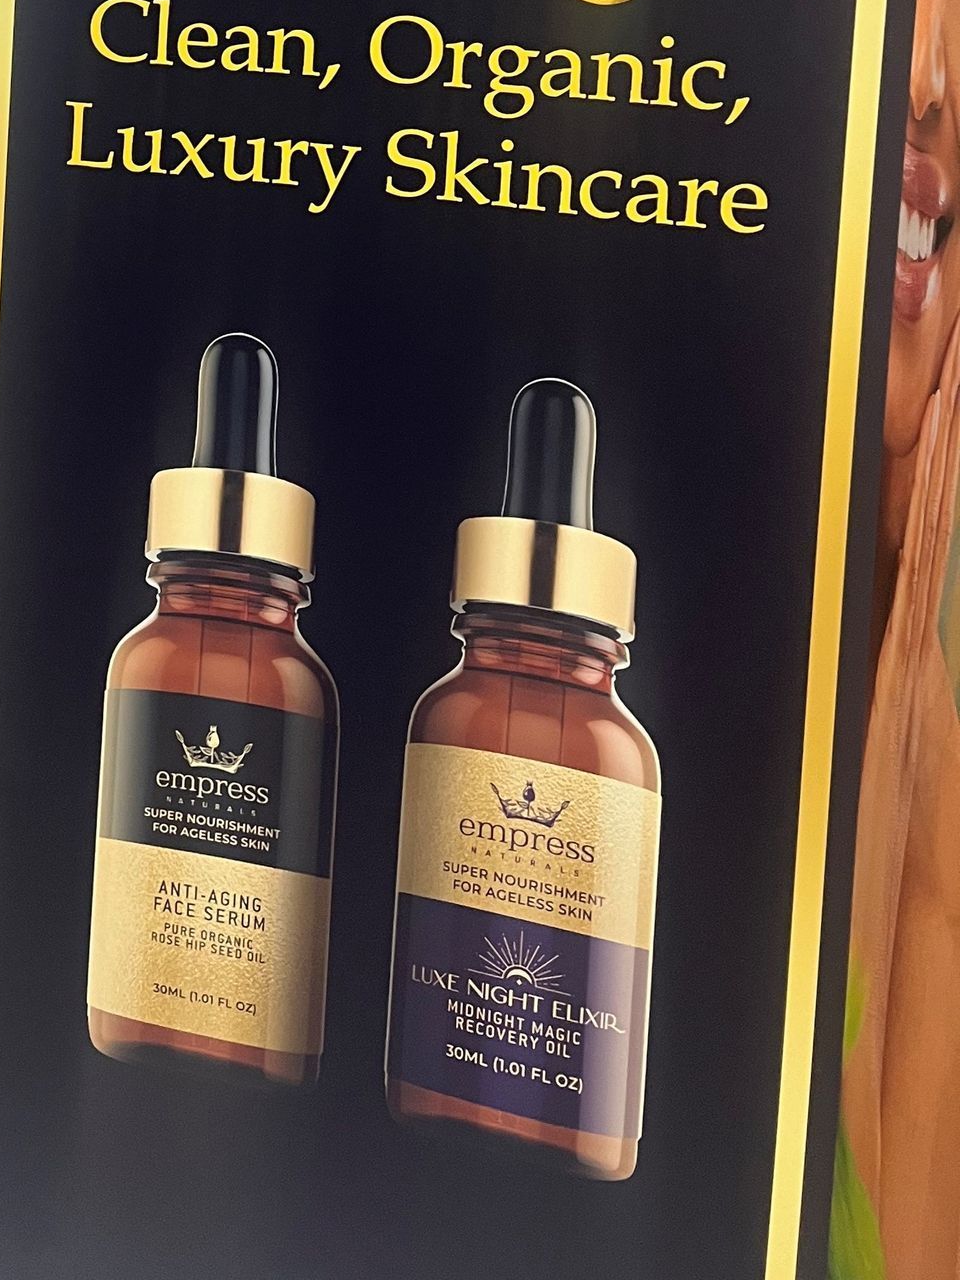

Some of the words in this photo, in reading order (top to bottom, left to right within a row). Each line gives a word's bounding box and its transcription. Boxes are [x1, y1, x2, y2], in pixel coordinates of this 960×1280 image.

[369, 15, 750, 125] Organic,
[66, 100, 362, 214] Luxury
[385, 128, 769, 234] Skincare
[156, 770, 270, 804] empress
[143, 807, 183, 822] SUPER
[186, 813, 281, 840] NOURISHMENT
[166, 795, 257, 817] NATURALS
[152, 822, 177, 835] FOR
[180, 826, 238, 846] AGELESS
[241, 837, 270, 852] SKIN
[459, 817, 595, 864] empress
[471, 846, 580, 877] NATURALS
[158, 880, 262, 913] ANTI-AGING
[443, 860, 488, 880] SUPER
[493, 871, 607, 908] NOURISHMENT
[453, 879, 481, 895] FOR
[485, 886, 554, 912] AGELESS
[558, 903, 593, 922] SKIN
[153, 896, 195, 918] FACE
[204, 906, 266, 932] SERUM
[151, 931, 180, 946] ROSE
[186, 939, 206, 952] HIP
[210, 944, 242, 960] SEED
[247, 951, 266, 964] OIL
[164, 922, 196, 938] PURE
[200, 929, 254, 950] ORGANIC
[152, 983, 186, 999] 30ML
[189, 991, 214, 1006] (1.01
[218, 997, 232, 1009] FL
[236, 1001, 257, 1016] OZ)
[411, 964, 460, 993] LUXE
[467, 977, 545, 1013] NIGHT
[552, 1000, 626, 1034] ELIXIR
[447, 998, 525, 1031] MIDNIGHT
[531, 1022, 582, 1046] MAGIC
[455, 1017, 540, 1050] RECOVERY
[545, 1040, 571, 1059] OIL
[445, 1044, 489, 1067] 30ML
[493, 1058, 526, 1079] (1.01
[531, 1067, 551, 1085] FL
[555, 1074, 584, 1095] OZ)
